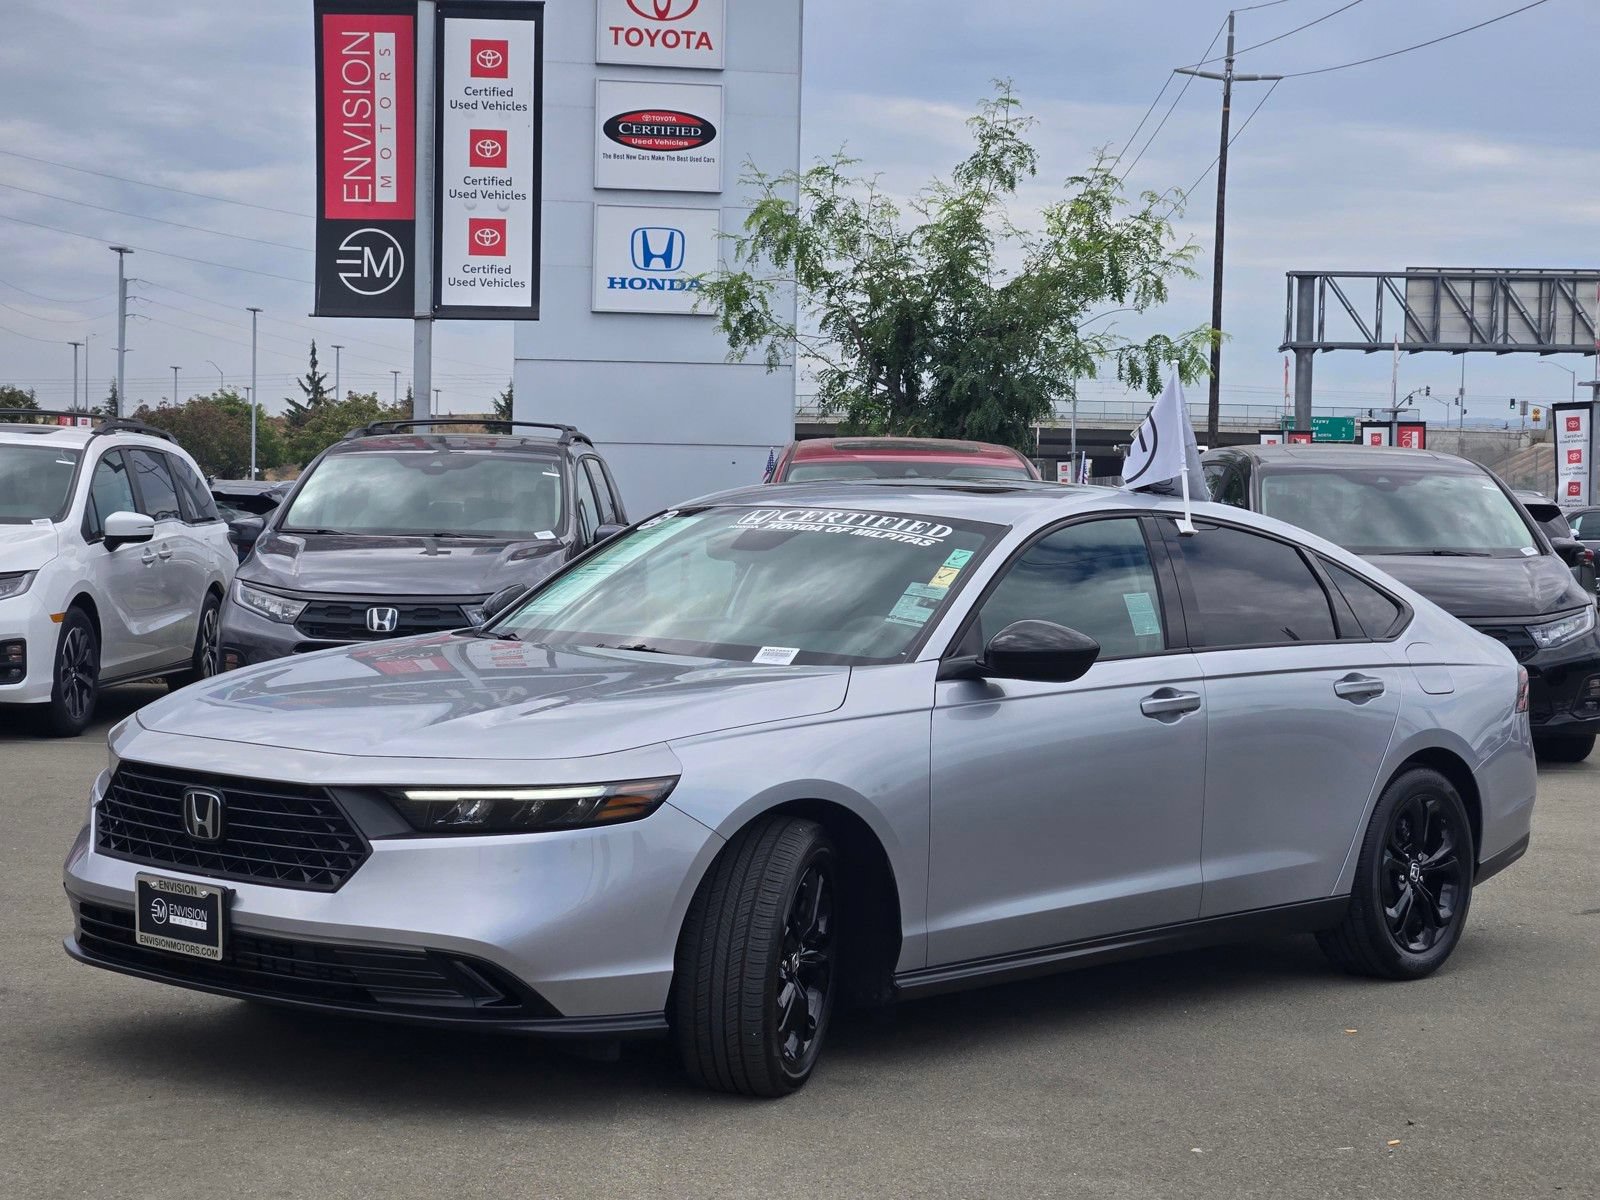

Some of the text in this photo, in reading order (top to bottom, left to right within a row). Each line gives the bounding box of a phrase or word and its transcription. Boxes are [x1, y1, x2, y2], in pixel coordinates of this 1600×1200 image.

[609, 26, 713, 51] TOYOTA
[464, 86, 514, 98] Certified
[450, 100, 528, 112] Used Vehicles
[341, 31, 372, 203] ENVISION
[379, 48, 392, 188] MOTORS
[618, 122, 702, 137] CERTIFIED
[655, 138, 689, 146] Vehicles
[463, 176, 513, 187] Certified
[449, 189, 527, 201] Used Vehicles
[462, 264, 512, 275] Certified
[448, 278, 526, 289] Used Vehicles
[607, 276, 702, 292] HONDA
[777, 510, 953, 538] CERTIFIED
[762, 523, 936, 547] HONDA OF MILPITAS
[159, 880, 198, 895] ENVISION
[169, 903, 208, 921] ENVISION
[140, 934, 219, 958] ENVISIONMOTORS.COM
